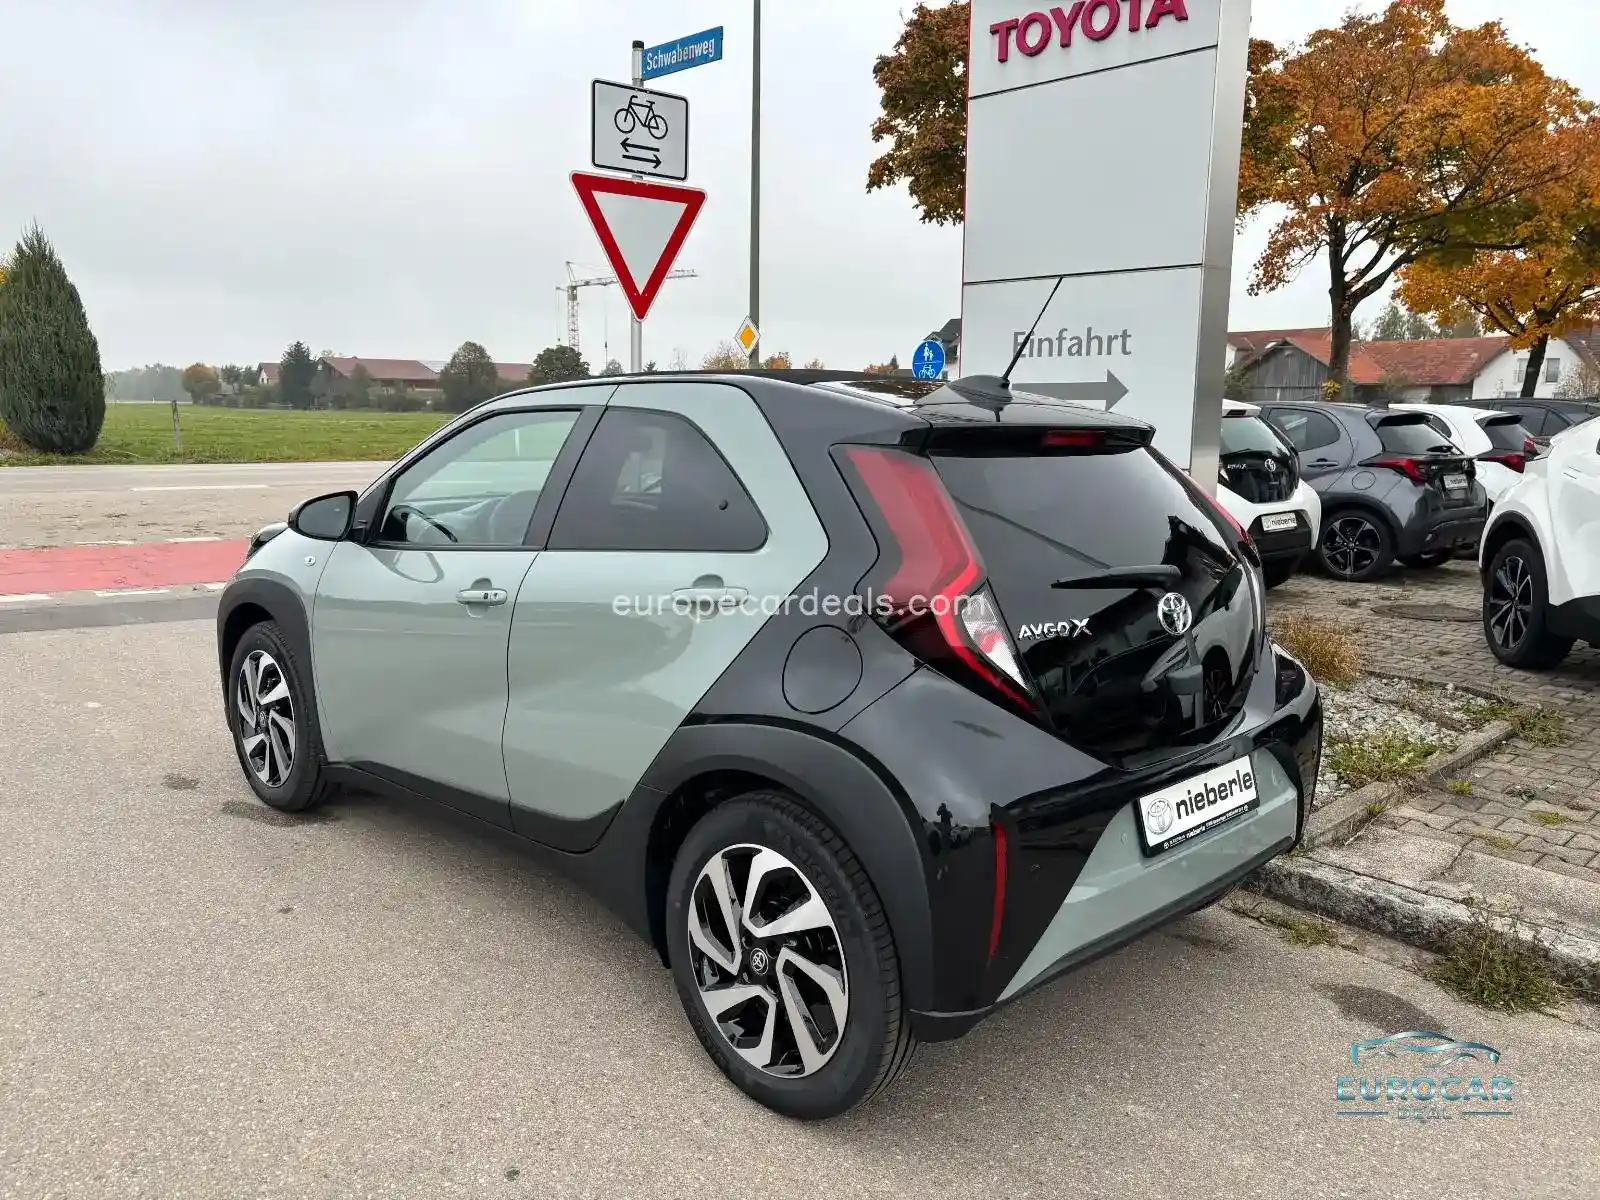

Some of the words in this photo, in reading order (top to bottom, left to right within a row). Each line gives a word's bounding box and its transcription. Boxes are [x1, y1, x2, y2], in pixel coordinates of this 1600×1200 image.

[990, 0, 1188, 63] TOYOTA
[647, 38, 715, 70] Schwabenweg
[1013, 327, 1132, 358] Einfahrt
[1176, 769, 1253, 819] nieberle
